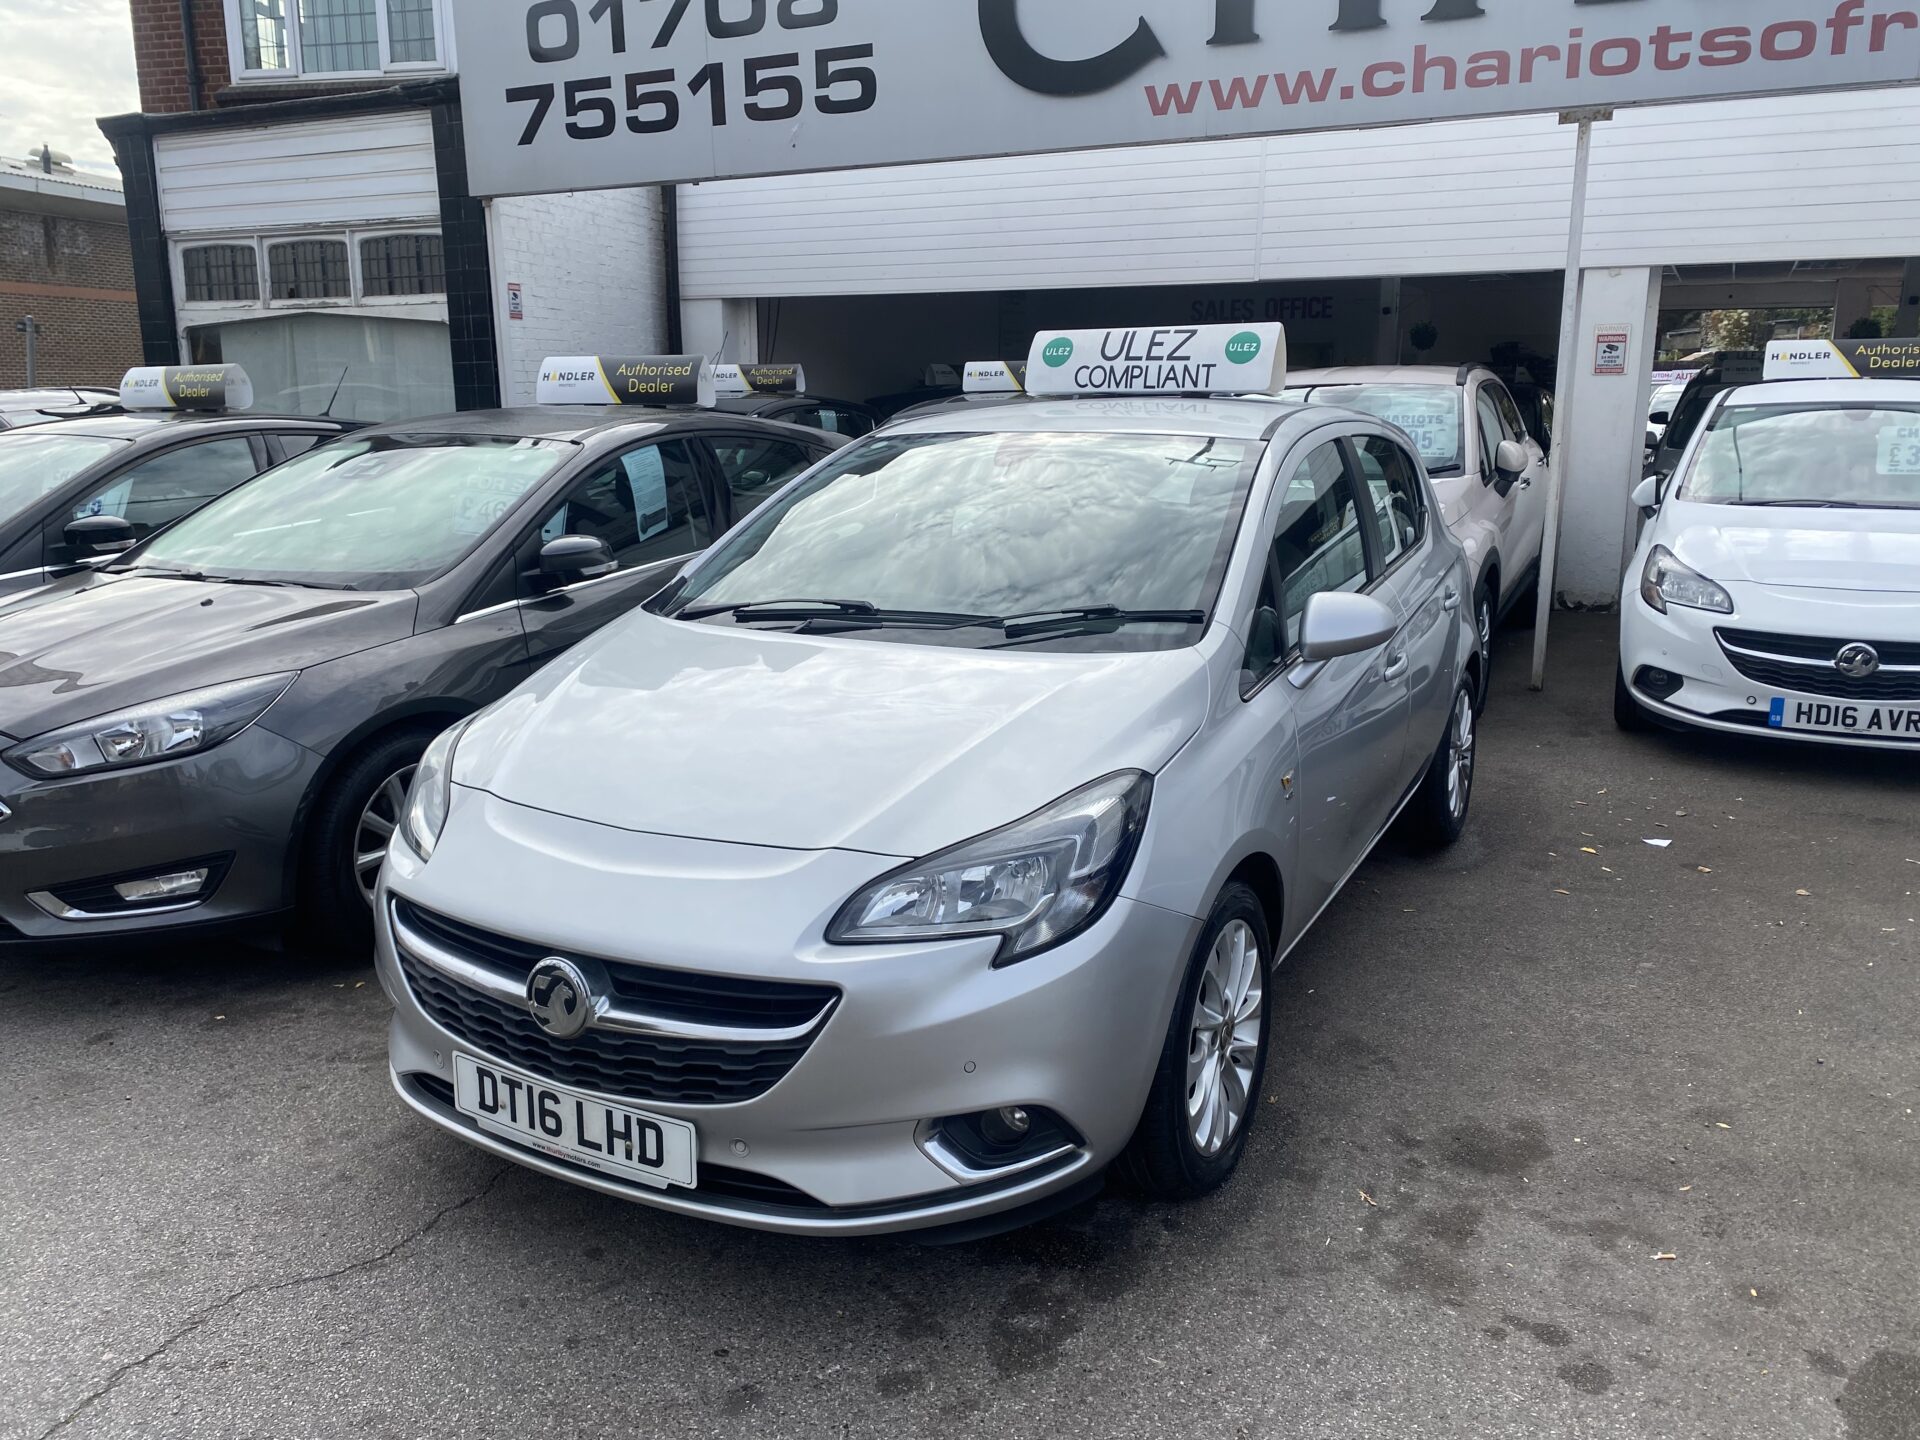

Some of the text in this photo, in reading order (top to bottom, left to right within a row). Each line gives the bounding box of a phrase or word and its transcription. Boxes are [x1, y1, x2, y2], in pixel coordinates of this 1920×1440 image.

[1144, 0, 1919, 117] www.chariotsofr
[504, 42, 877, 146] 755155
[1190, 296, 1333, 321] SALES OFFICE
[1046, 347, 1071, 357] ULEZ
[1100, 329, 1198, 361] ULEZ
[1229, 342, 1257, 353] ULEZ
[172, 370, 224, 383] Authorised
[616, 362, 692, 376] Authorised
[749, 367, 794, 376] Authorised
[1074, 363, 1217, 389] COMPLIANT
[628, 378, 675, 393] Dealer
[757, 377, 783, 385] Dealer
[179, 384, 211, 397] Dealer
[1795, 702, 1920, 733] HD16 AVR
[476, 1065, 664, 1168] DT16 LHD
